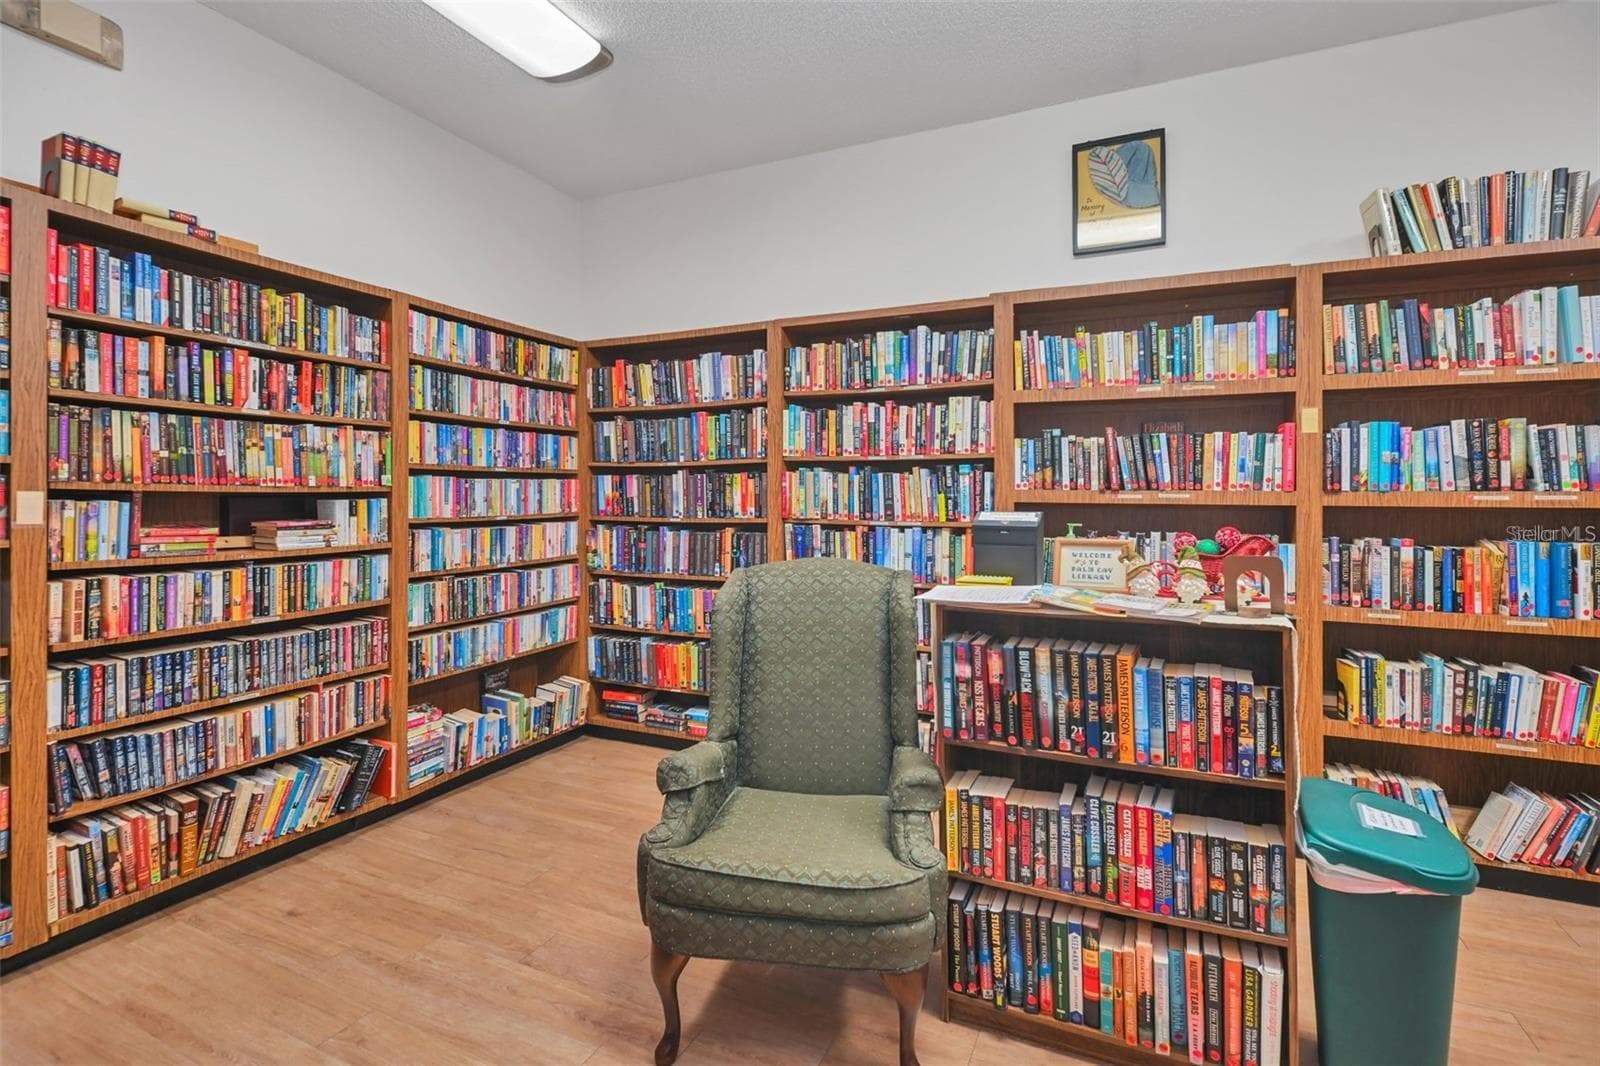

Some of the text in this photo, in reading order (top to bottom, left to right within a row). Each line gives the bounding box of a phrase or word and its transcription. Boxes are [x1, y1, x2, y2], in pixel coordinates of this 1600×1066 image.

[974, 646, 982, 677] PATTERSON
[1070, 654, 1080, 719] JAMES PATTERSON
[1102, 658, 1113, 724] JAMES PATTERSON
[1118, 659, 1130, 736] JAMES PATTERSON
[1197, 689, 1206, 708] JAMES
[1102, 731, 1117, 746] 21
[1198, 709, 1207, 742] PATTERSON
[948, 800, 957, 852] JAMES PATTERSON
[1089, 798, 1100, 853] CLIVE CUSSLER
[1106, 805, 1114, 824] CLIVE
[1061, 817, 1071, 868] JAMES PATTERSON
[1107, 825, 1115, 855] CUSSLER
[991, 913, 1002, 978] STUART WOODS
[1208, 962, 1218, 1002] AFTERMATH
[1245, 969, 1253, 986] LISA
[1191, 992, 1199, 1015] TEARS
